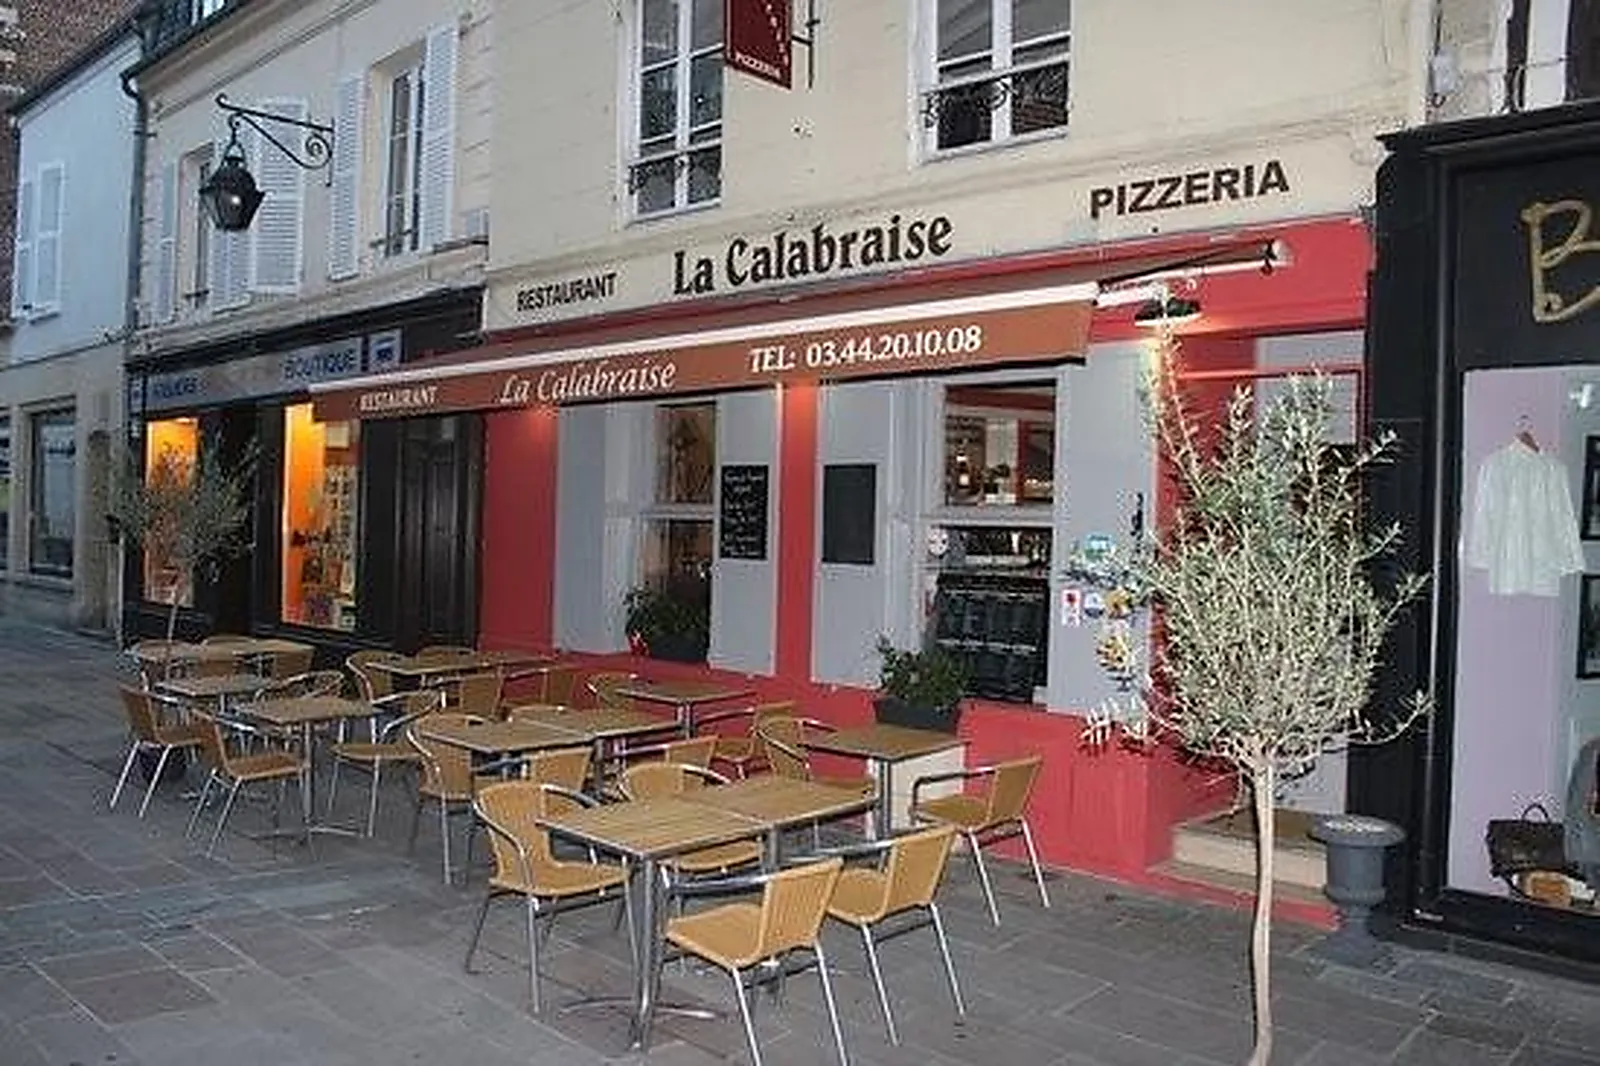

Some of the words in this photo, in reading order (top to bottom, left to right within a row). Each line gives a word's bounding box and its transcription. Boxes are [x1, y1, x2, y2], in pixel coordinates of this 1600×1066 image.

[735, 51, 781, 80] PIZZERIA
[1090, 159, 1290, 220] PIZZERIA
[673, 249, 715, 295] La
[726, 214, 953, 287] Calabraise
[517, 272, 618, 312] RESTAURANT
[284, 348, 358, 381] BOUTIQUE
[750, 346, 796, 372] TEL:
[805, 325, 982, 368] 03.44.20.10.08
[359, 386, 438, 412] RESTAURANT
[499, 374, 530, 404] La
[536, 358, 677, 402] Calabraise
